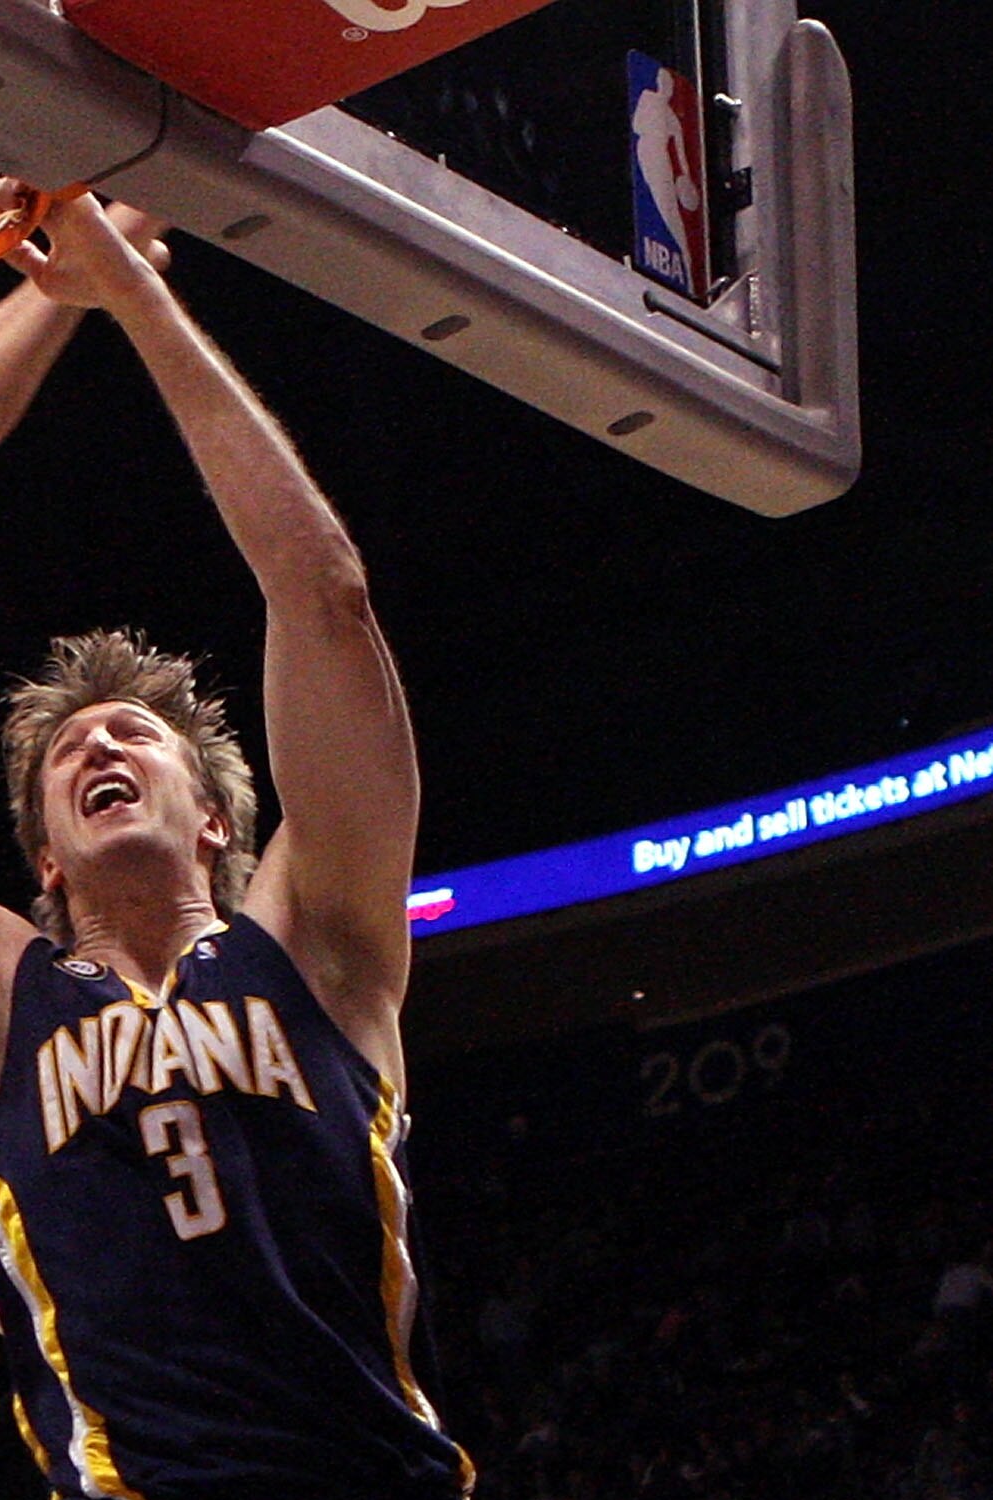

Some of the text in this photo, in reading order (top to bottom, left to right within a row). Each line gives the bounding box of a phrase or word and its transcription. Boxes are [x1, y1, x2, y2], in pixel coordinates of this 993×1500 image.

[643, 235, 686, 286] NBA
[632, 837, 691, 874] Buy
[694, 812, 755, 857] and
[758, 797, 808, 841] sell
[809, 774, 910, 826] tickets
[911, 760, 947, 797] at
[37, 995, 319, 1156] INDIANA
[138, 1099, 229, 1241] 3
